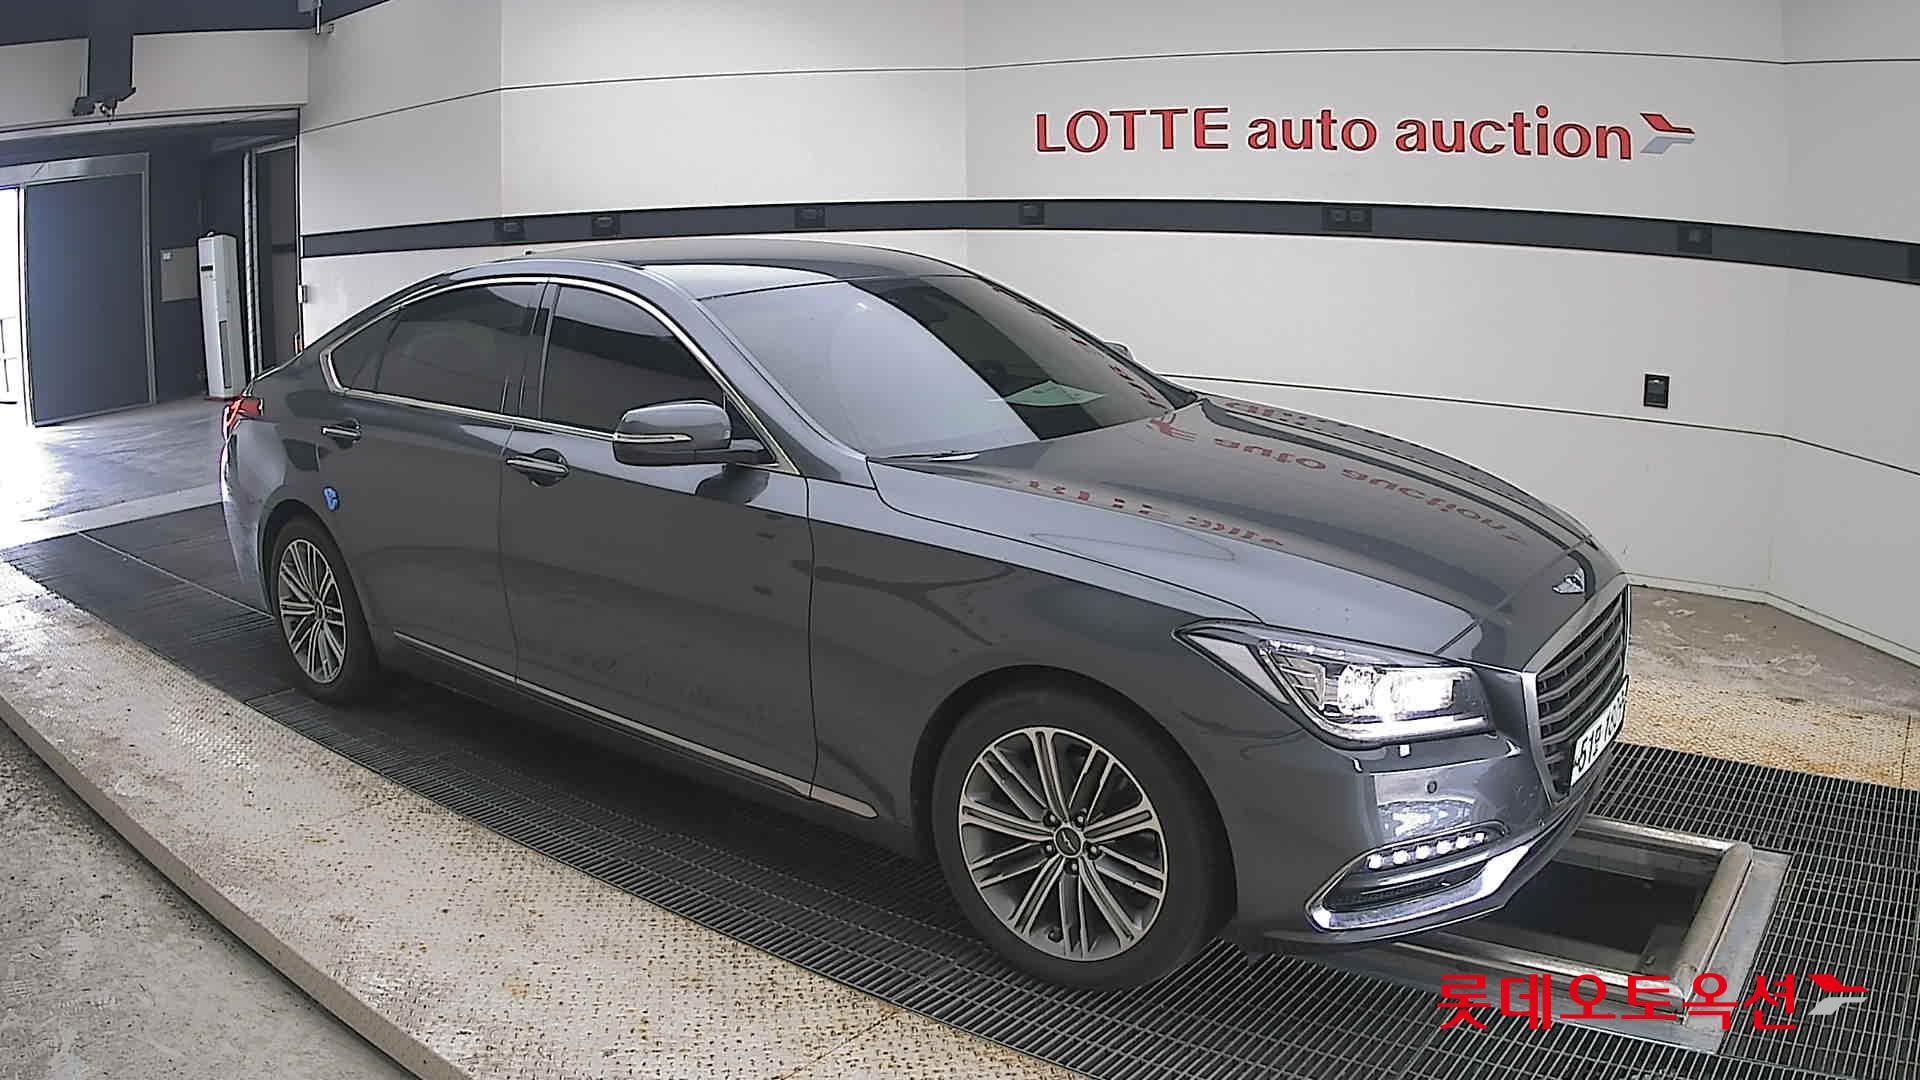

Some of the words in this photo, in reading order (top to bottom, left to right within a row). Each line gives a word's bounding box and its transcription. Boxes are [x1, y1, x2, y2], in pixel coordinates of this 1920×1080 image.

[1035, 107, 1229, 153] LOTTE
[1246, 109, 1378, 151] auto
[1395, 105, 1633, 160] auction
